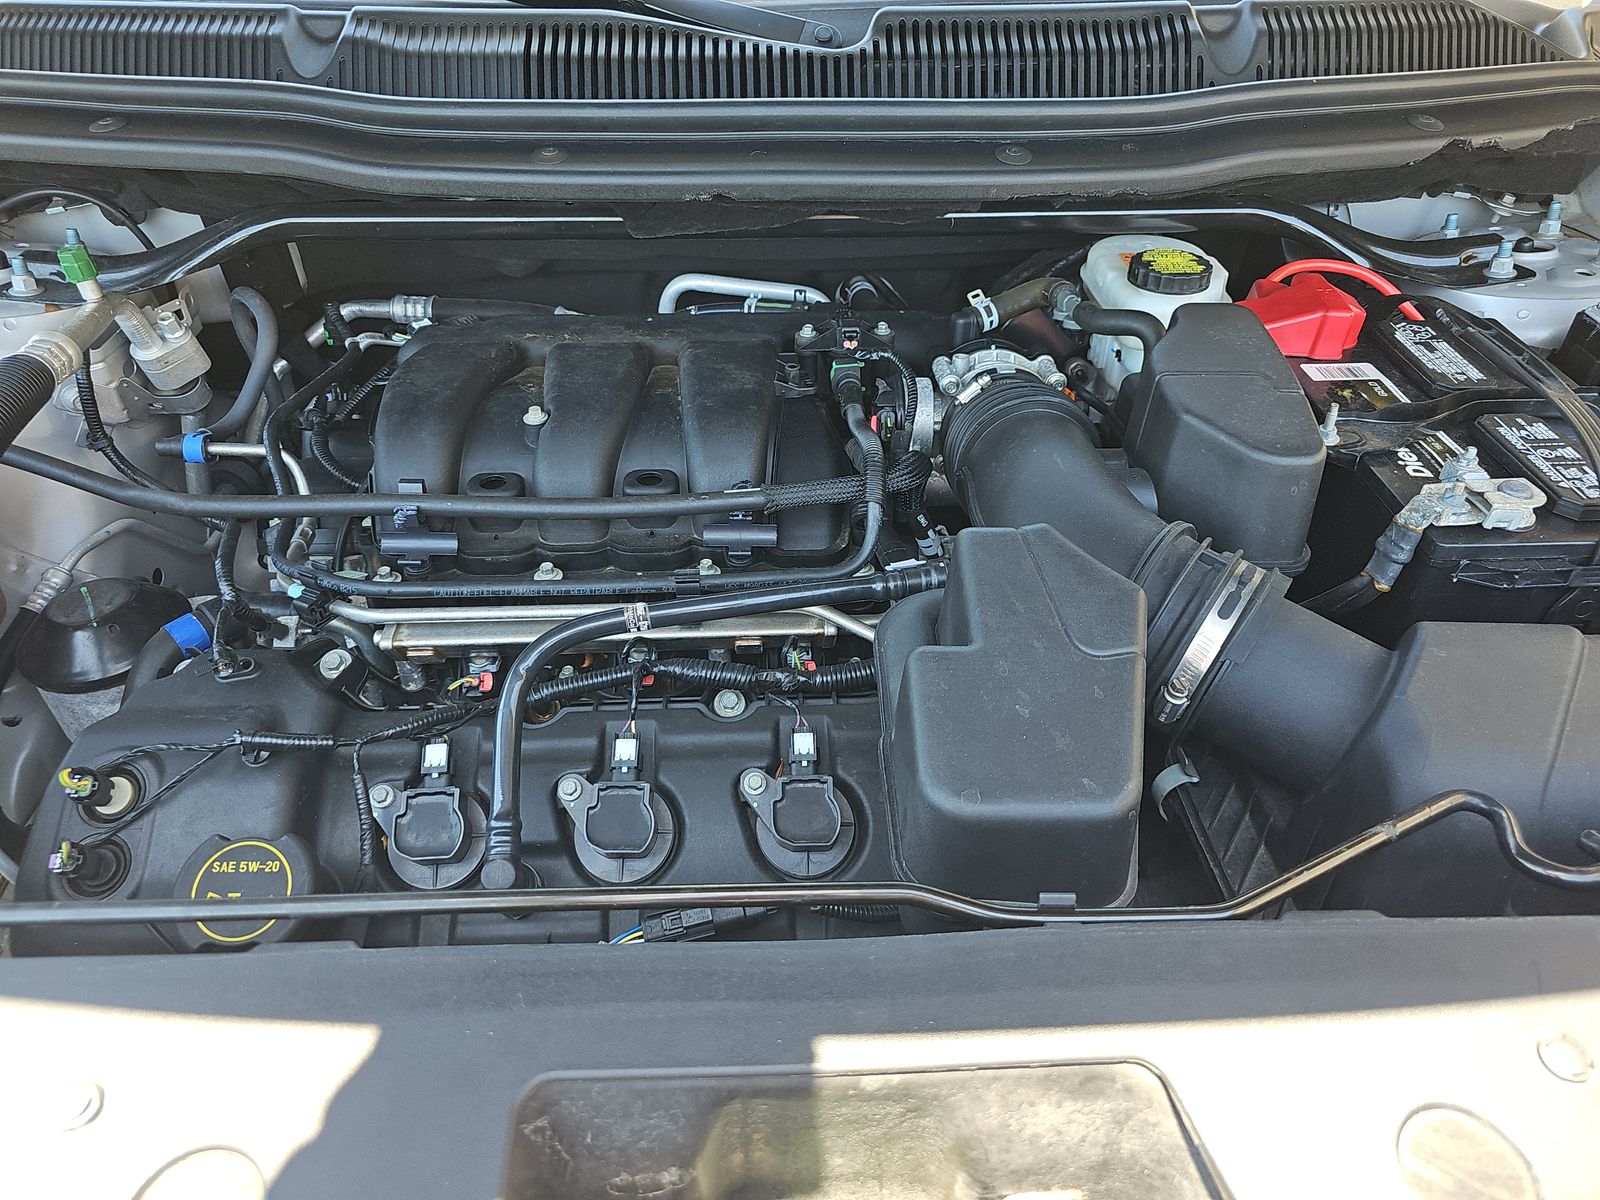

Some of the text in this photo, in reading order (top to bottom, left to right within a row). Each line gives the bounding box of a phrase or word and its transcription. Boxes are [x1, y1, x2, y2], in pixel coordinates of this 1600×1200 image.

[1368, 381, 1388, 397] GOLD
[1496, 426, 1528, 450] POISON
[1527, 454, 1562, 481] DANGER
[212, 860, 280, 873] SAE 5W-20
